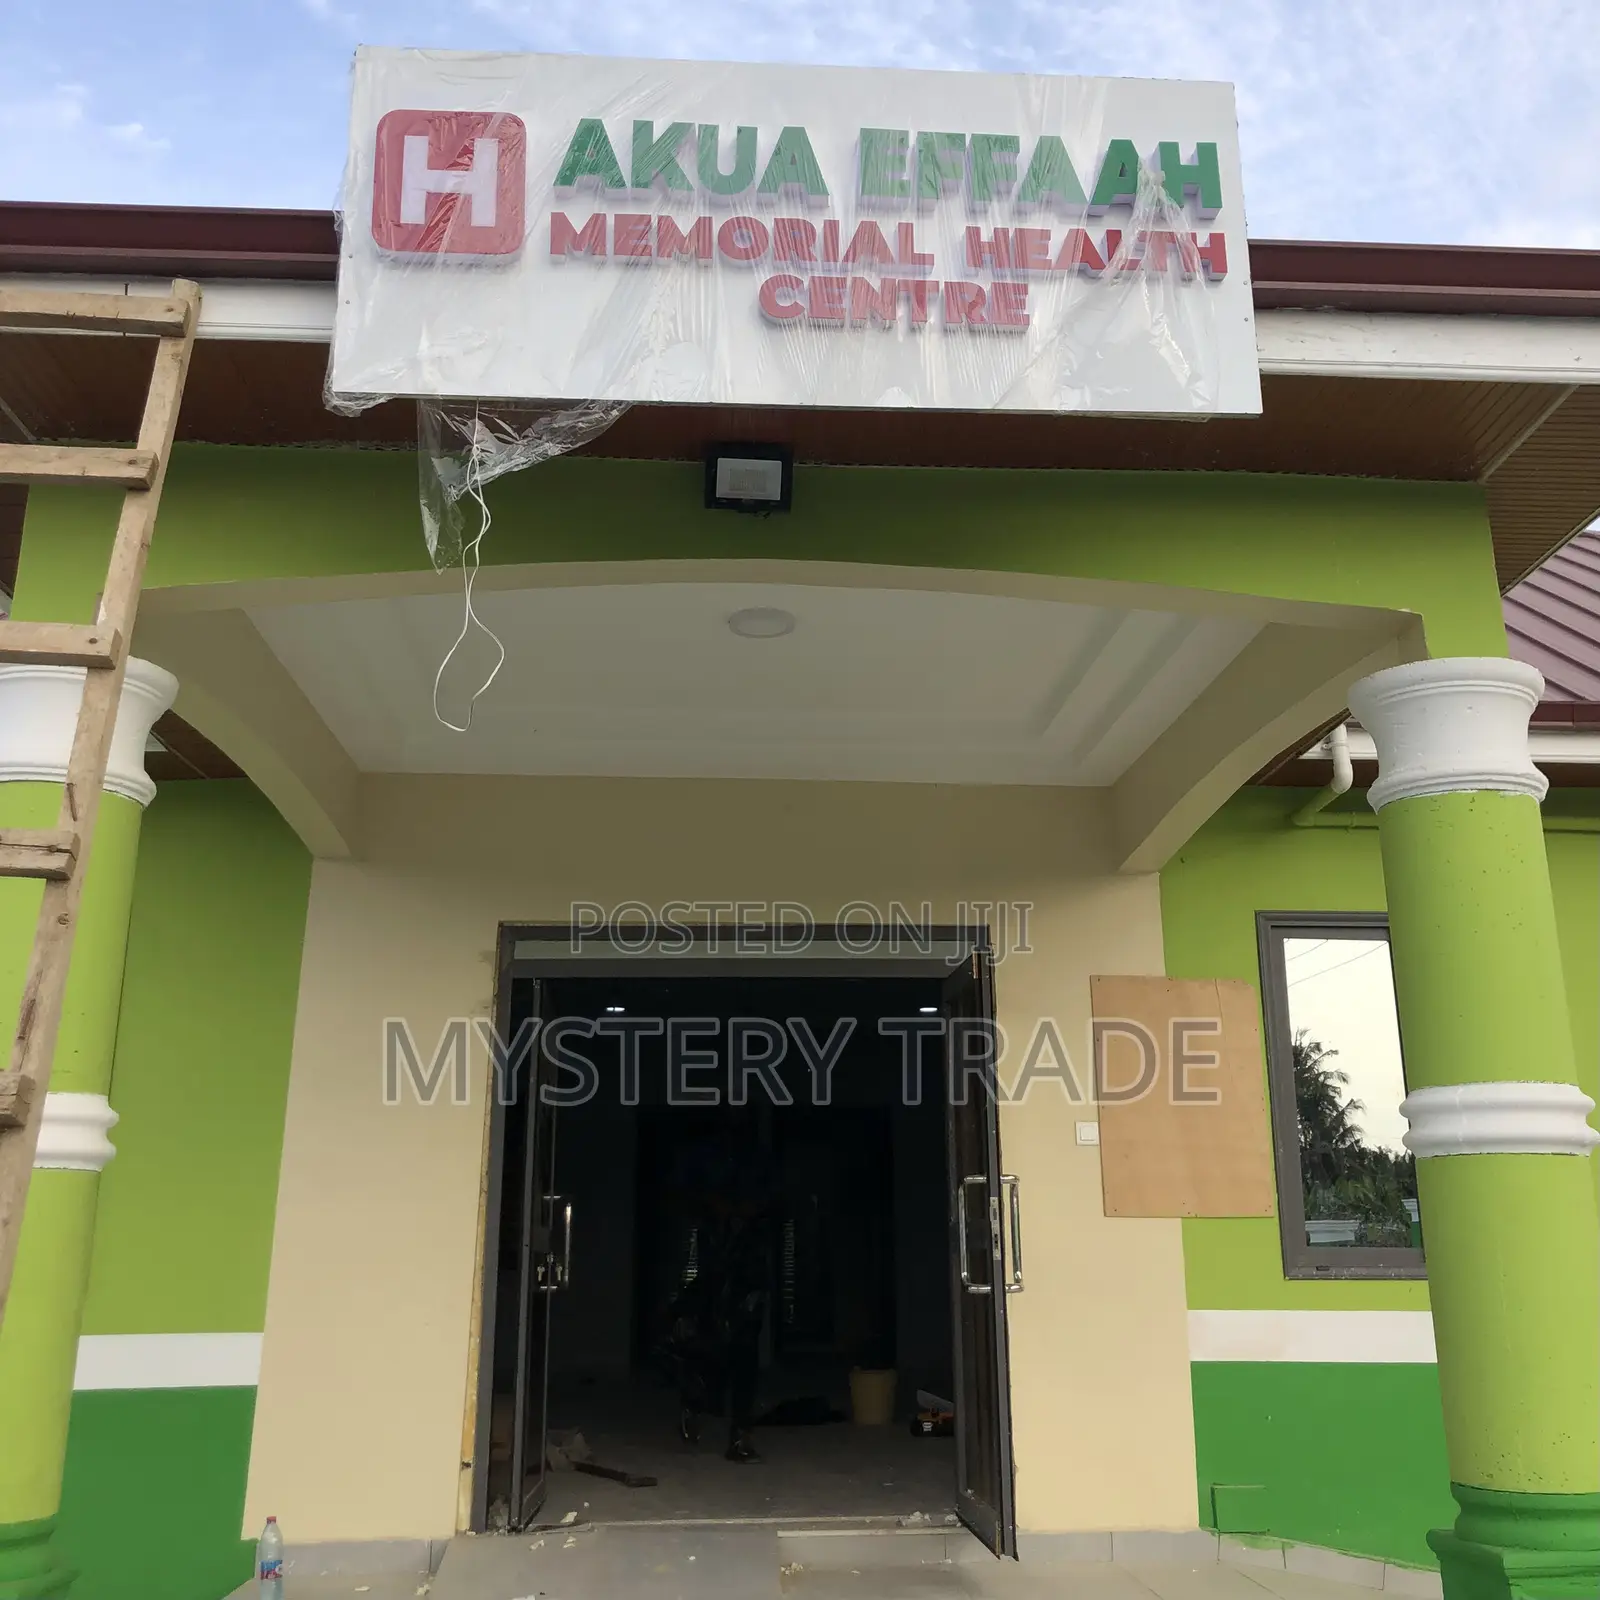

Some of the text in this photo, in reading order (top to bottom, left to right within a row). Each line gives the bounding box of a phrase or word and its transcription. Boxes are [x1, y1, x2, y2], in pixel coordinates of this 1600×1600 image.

[400, 134, 499, 228] H
[552, 117, 1223, 213] AKUA EFFAAH
[549, 211, 1229, 277] MEMORIAL HEALTH
[758, 273, 1031, 330] CENTRE
